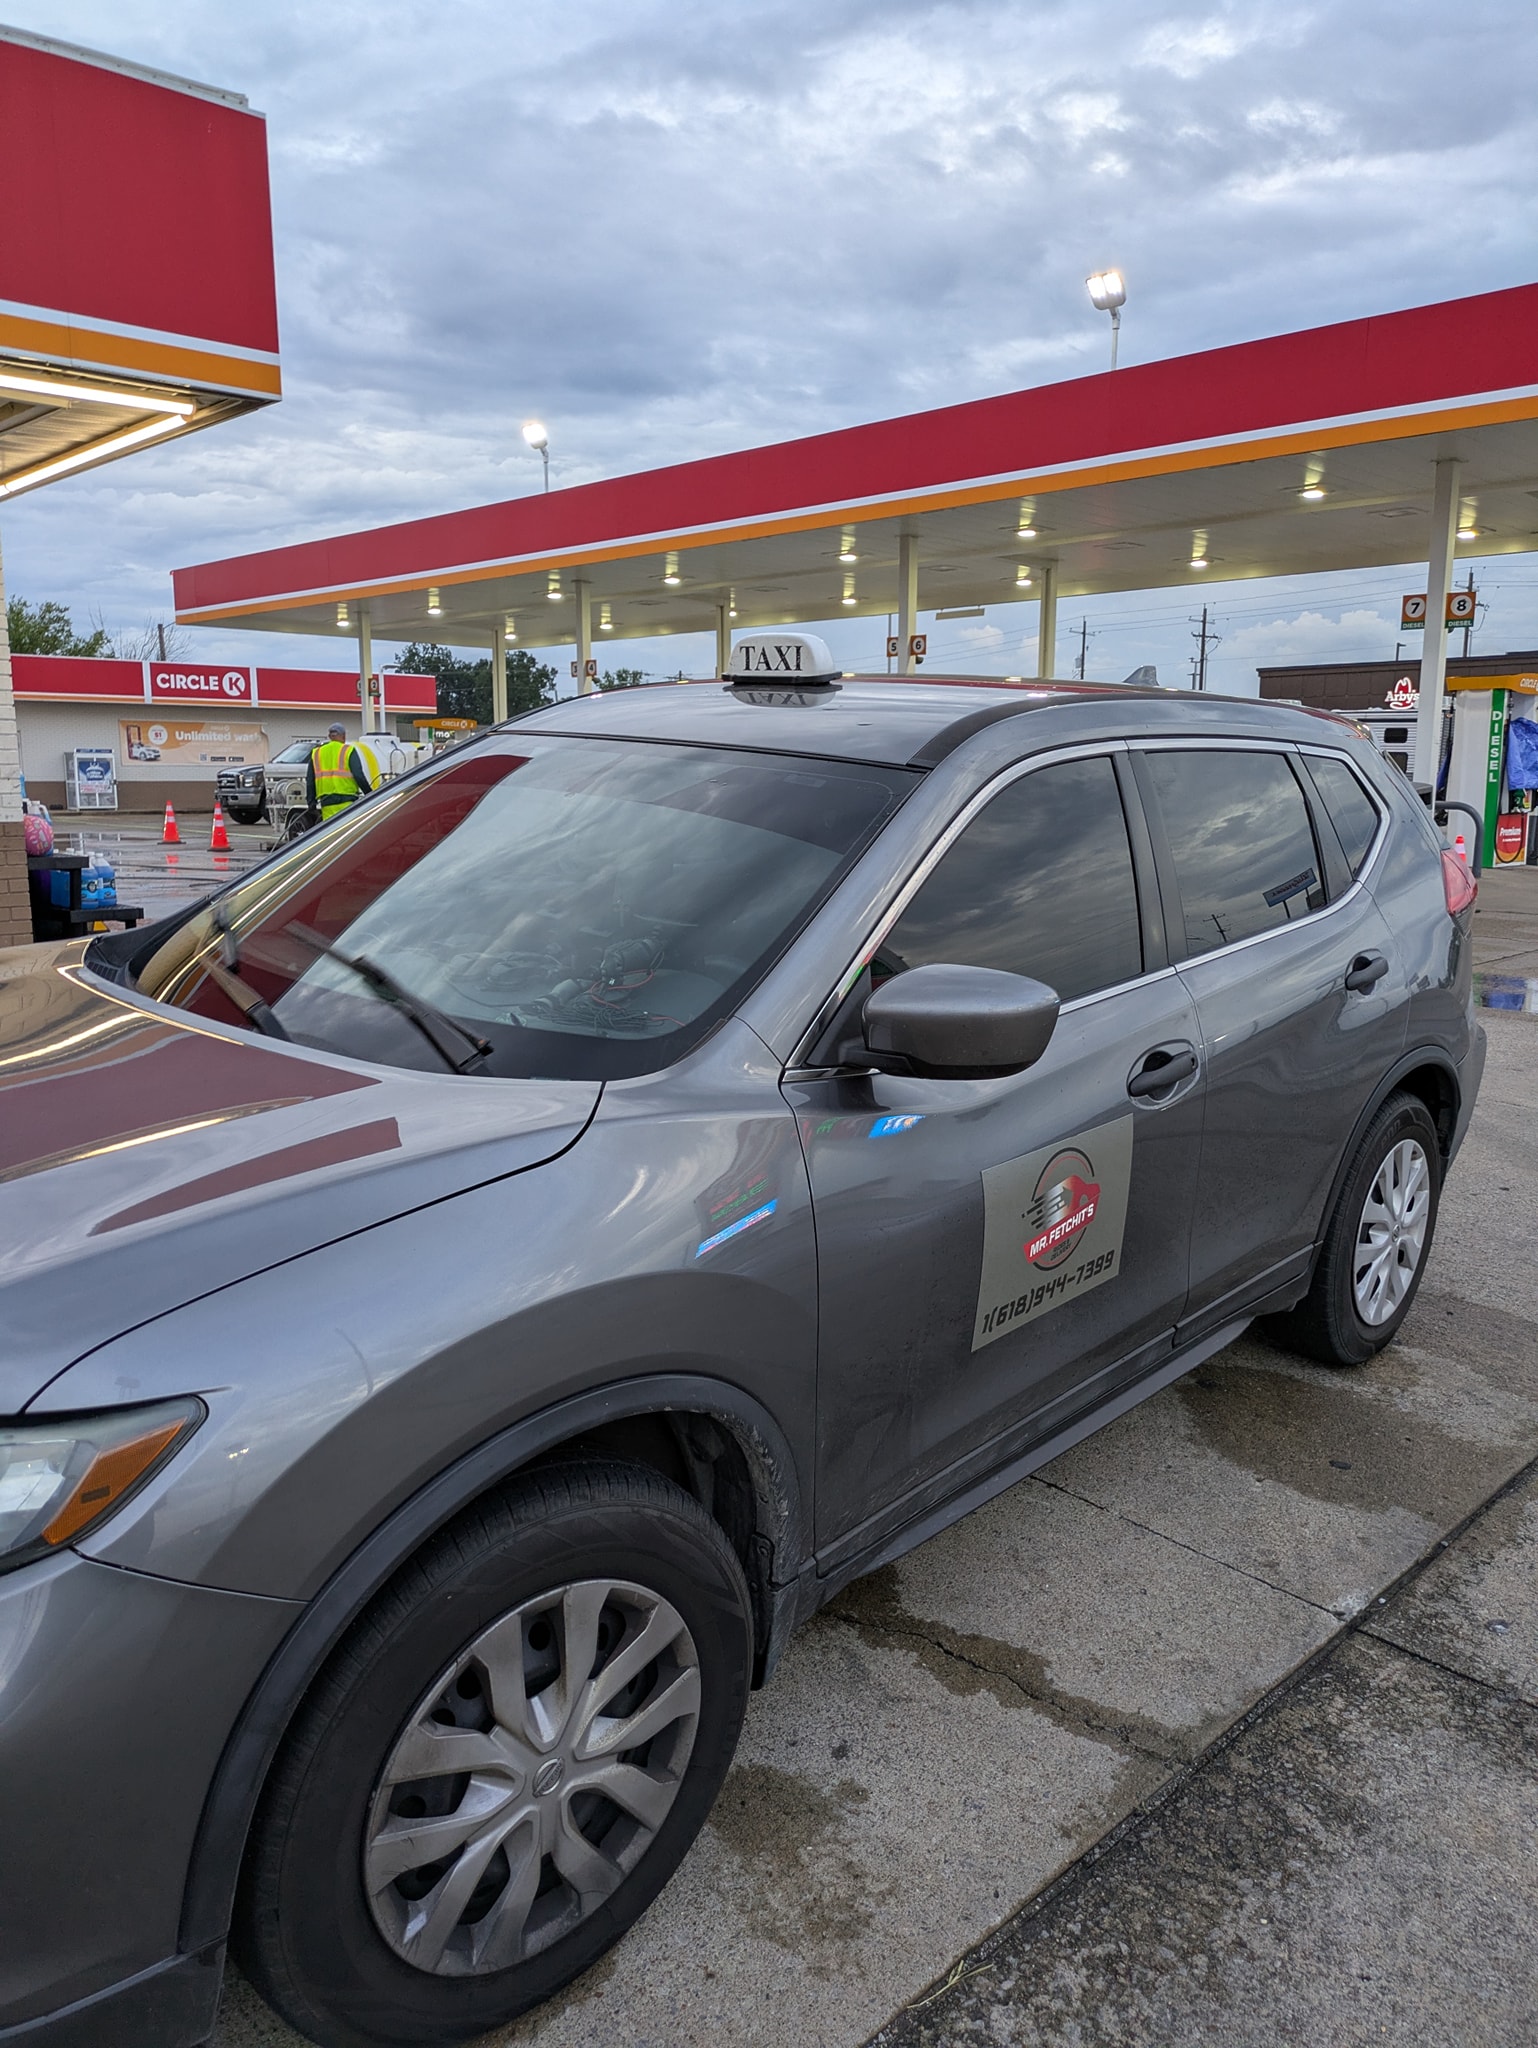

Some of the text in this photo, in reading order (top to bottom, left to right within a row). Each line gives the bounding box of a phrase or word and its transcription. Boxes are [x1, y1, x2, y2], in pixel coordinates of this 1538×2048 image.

[1410, 602, 1421, 614] 7
[1456, 598, 1467, 612] 8
[915, 639, 922, 650] 6
[739, 644, 803, 671] TAXI
[156, 671, 246, 697] CIRCLE K
[1384, 689, 1420, 704] Arby's
[175, 730, 231, 742] Unlimited
[1488, 710, 1503, 783] DIESEL
[1029, 1203, 1094, 1258] MR. FETCHIT'S
[982, 1249, 1115, 1335] 1(618)944-7399
